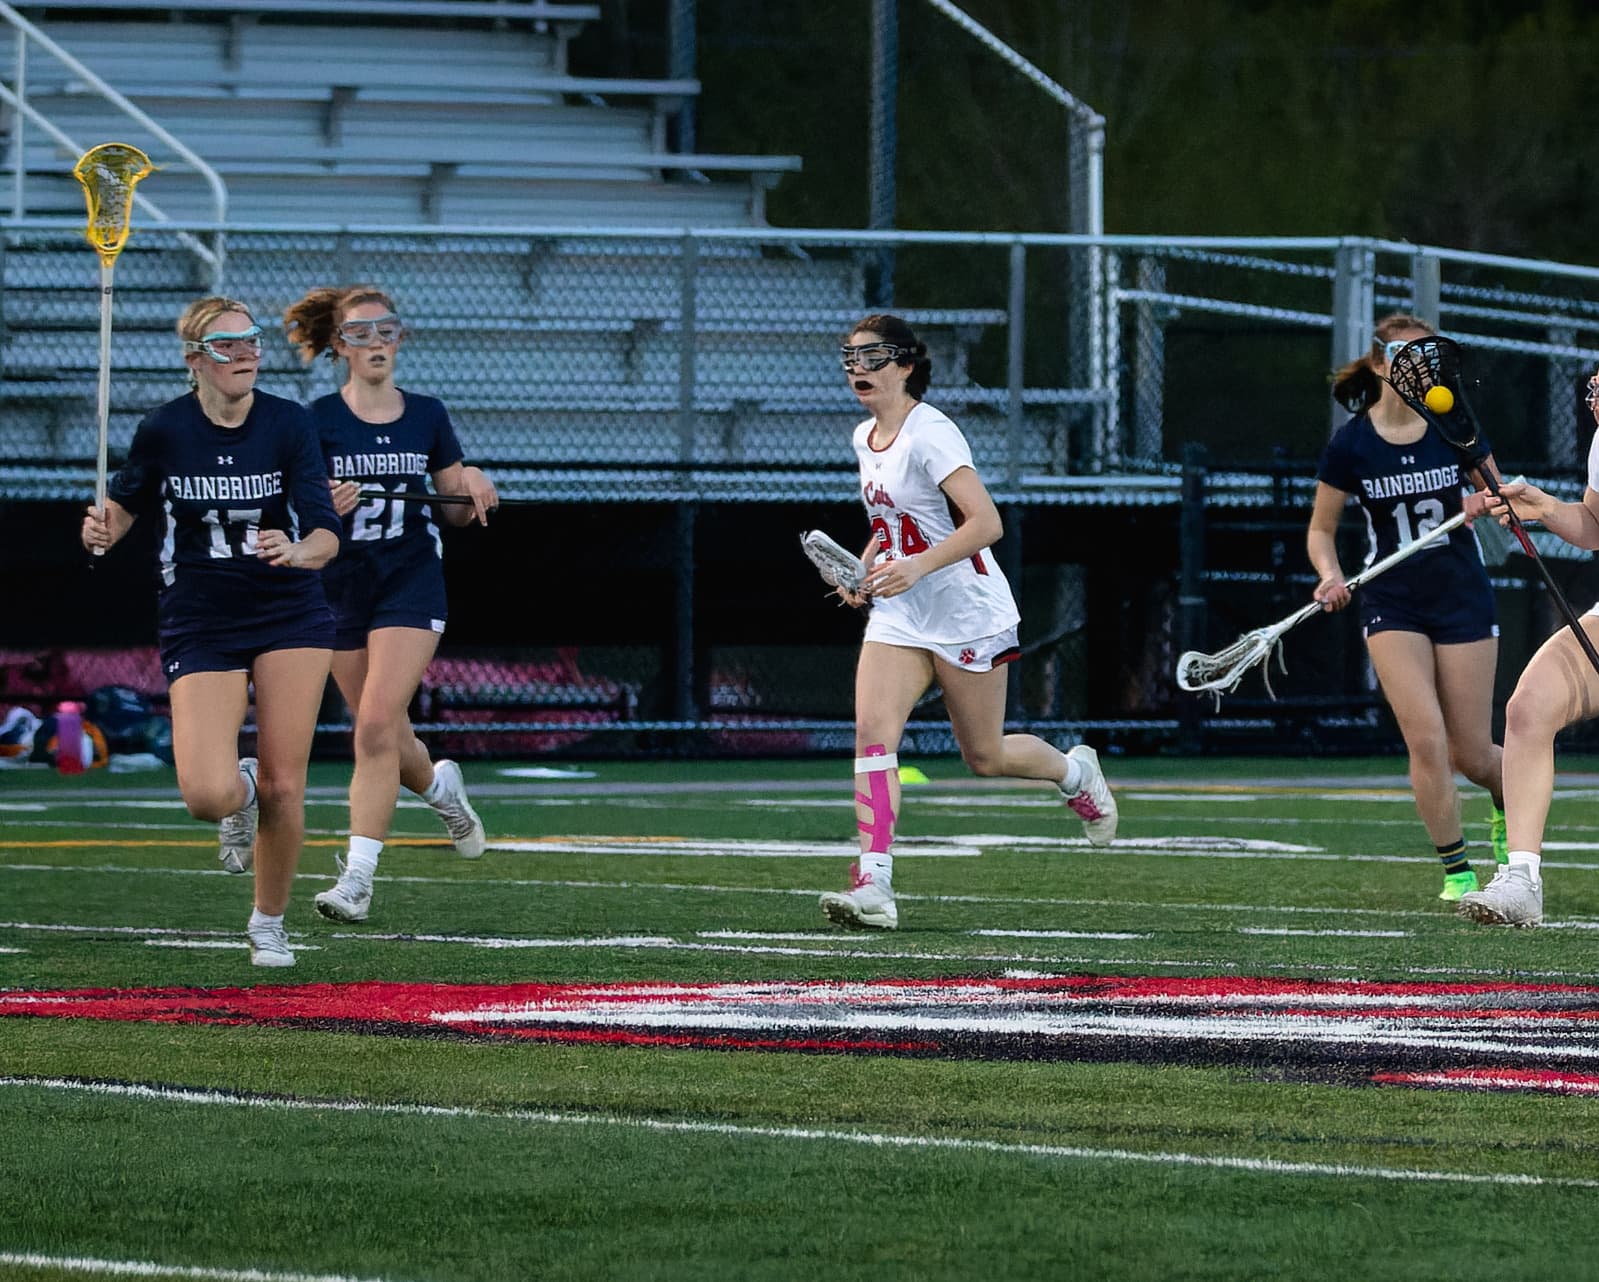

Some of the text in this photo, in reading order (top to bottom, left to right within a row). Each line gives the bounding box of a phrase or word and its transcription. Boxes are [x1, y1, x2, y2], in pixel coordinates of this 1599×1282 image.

[168, 471, 284, 500] BAINBRIDGE
[1362, 464, 1459, 499] BAINBRIDGE
[201, 509, 263, 558] 17
[351, 482, 408, 541] 21
[1391, 498, 1451, 550] 12
